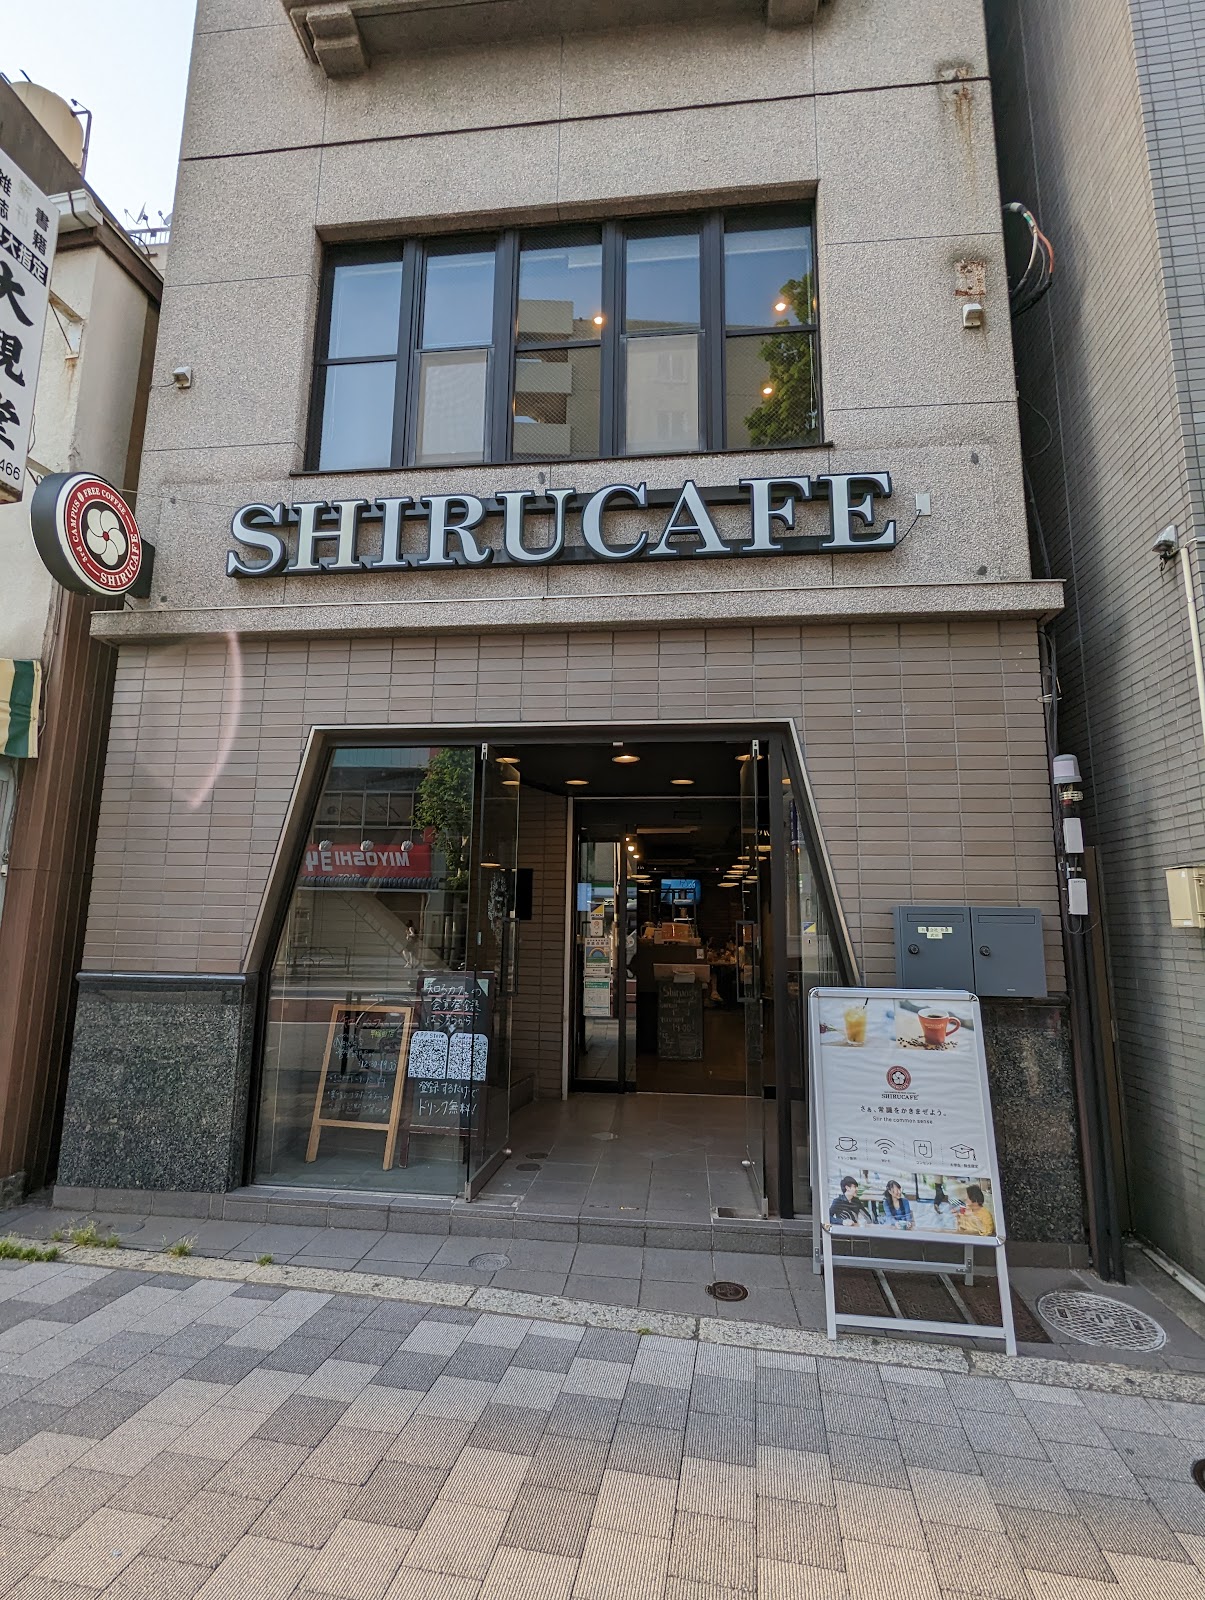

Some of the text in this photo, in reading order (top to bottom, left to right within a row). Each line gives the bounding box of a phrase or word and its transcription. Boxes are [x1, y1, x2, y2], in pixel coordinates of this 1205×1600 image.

[0, 224, 48, 286] 大指定
[33, 207, 49, 256] 書籍
[70, 499, 81, 543] CAMPUS
[83, 487, 101, 498] FREE
[101, 489, 126, 515] COFFEE
[226, 471, 898, 577] SHIRUCAFE
[100, 533, 139, 586] SHIRUCAFE
[430, 998, 481, 1013] 会員登録
[881, 1093, 918, 1101] SHIRUCAFE
